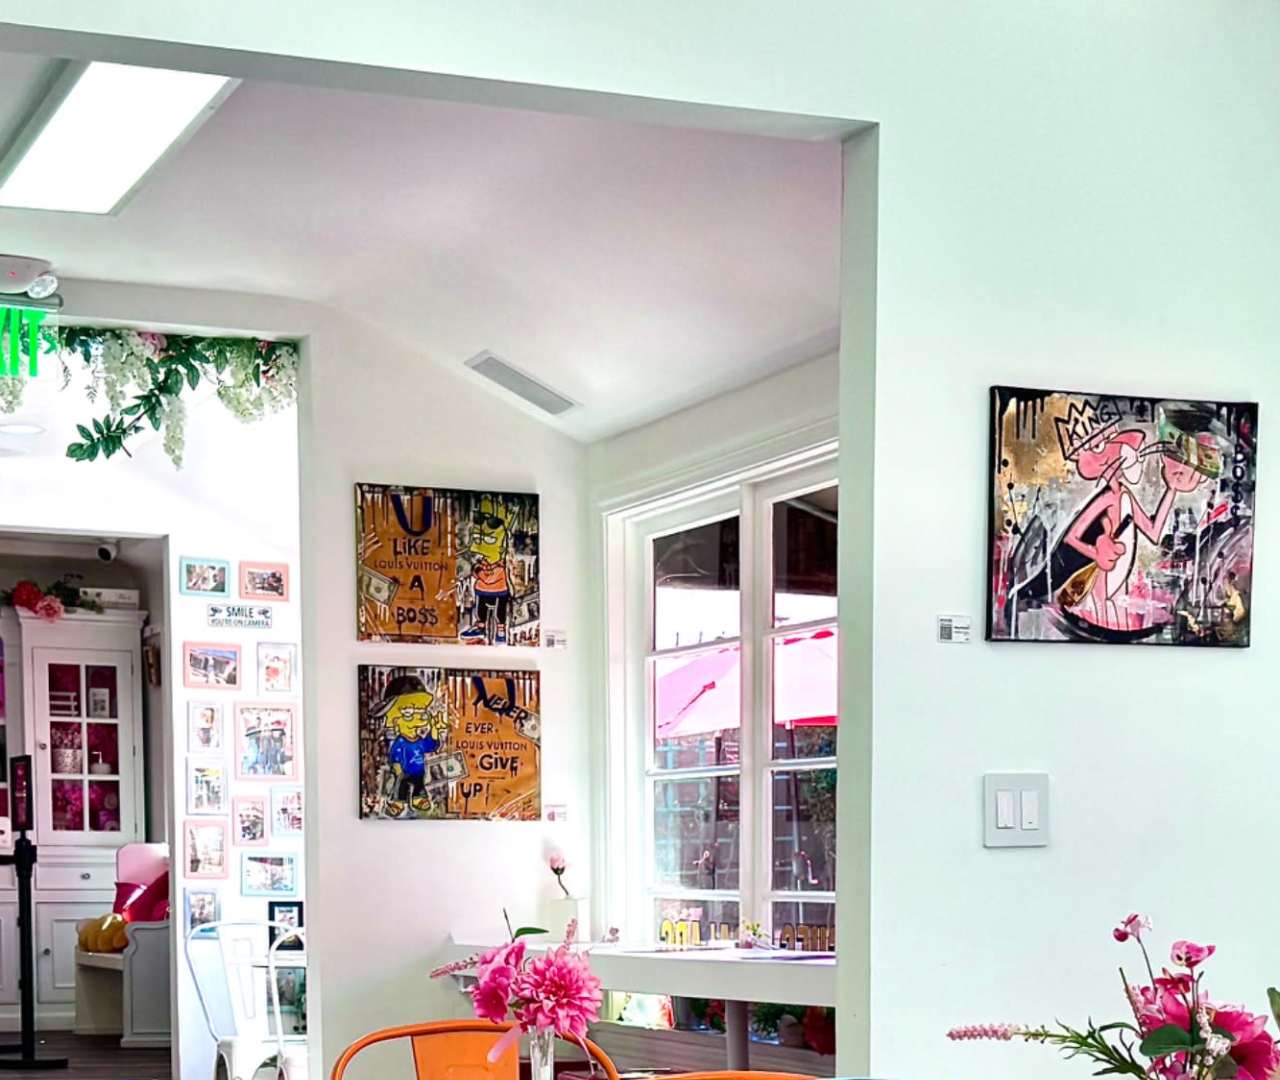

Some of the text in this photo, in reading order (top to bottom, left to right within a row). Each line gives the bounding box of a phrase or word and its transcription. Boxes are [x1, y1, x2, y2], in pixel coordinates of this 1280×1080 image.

[1065, 404, 1118, 447] KING
[374, 560, 448, 572] LOUIS VUITTON
[409, 575, 425, 592] A
[226, 606, 254, 618] SMILE
[472, 693, 528, 728] NEVER
[465, 722, 494, 734] EVER
[455, 740, 528, 751] LOUIS VUITTON
